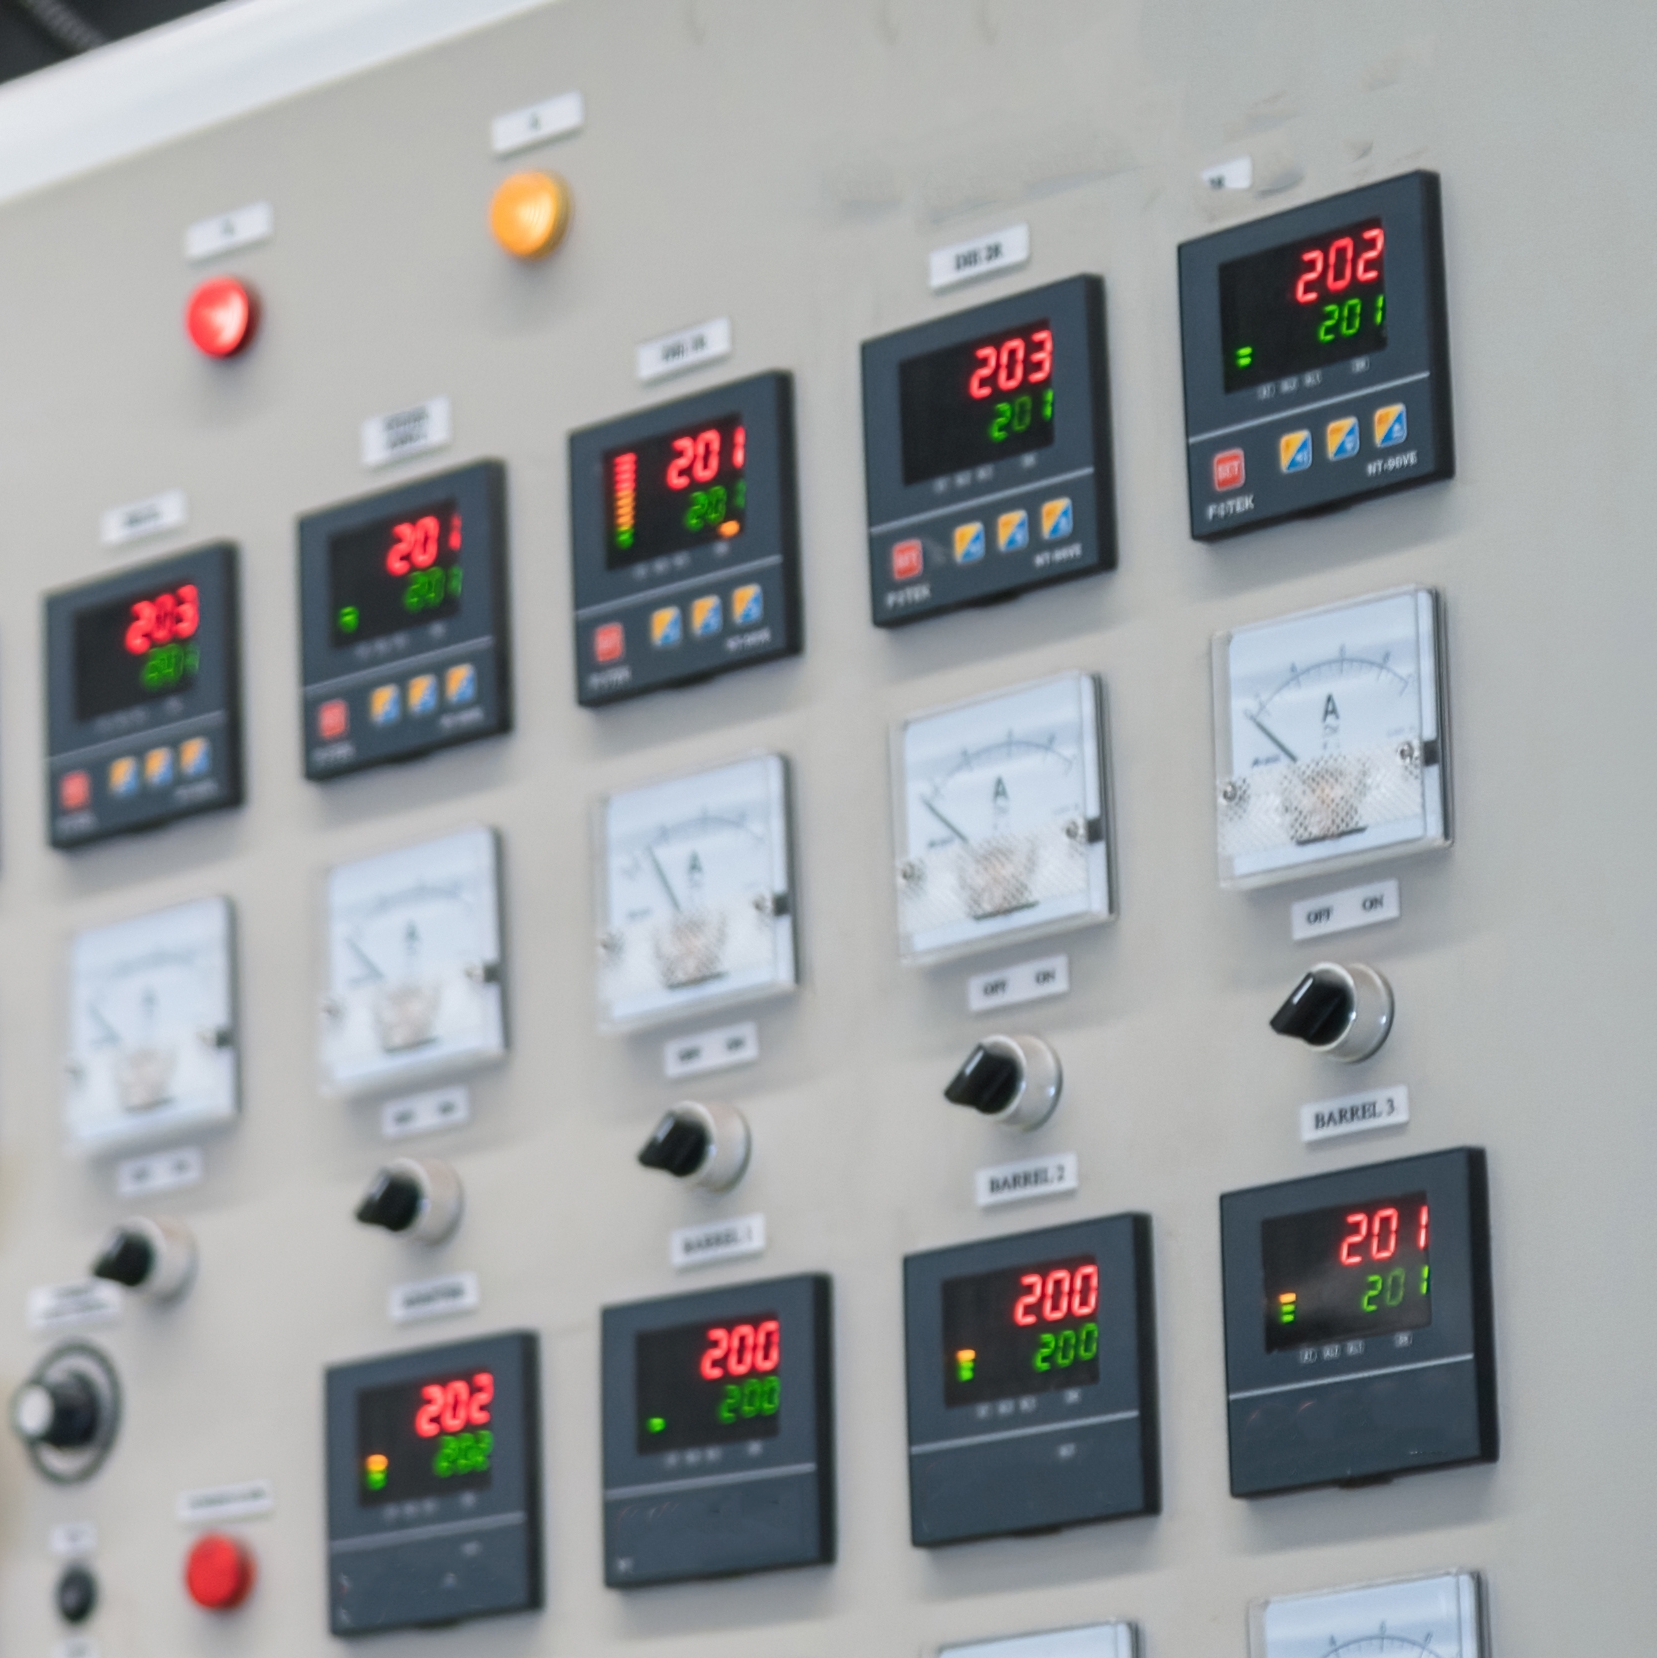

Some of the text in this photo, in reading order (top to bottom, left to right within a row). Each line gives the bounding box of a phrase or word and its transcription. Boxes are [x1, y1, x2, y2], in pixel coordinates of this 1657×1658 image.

[1296, 228, 1385, 306] 202
[1317, 295, 1386, 346] 201
[969, 329, 1053, 401] 203
[988, 389, 1055, 445] 201
[666, 425, 747, 493] 201
[386, 515, 463, 579] 201
[1322, 693, 1340, 723] A
[1306, 894, 1384, 926] OFF ON
[1315, 1097, 1395, 1130] BARREL 3
[990, 1167, 1054, 1194] BARREL
[1340, 1206, 1430, 1268] 201
[1013, 1264, 1099, 1328] 200
[1361, 1265, 1431, 1314] 201
[700, 1319, 781, 1382] 200
[1031, 1322, 1100, 1375] 200
[415, 1371, 495, 1441] 202
[718, 1375, 782, 1426] 200
